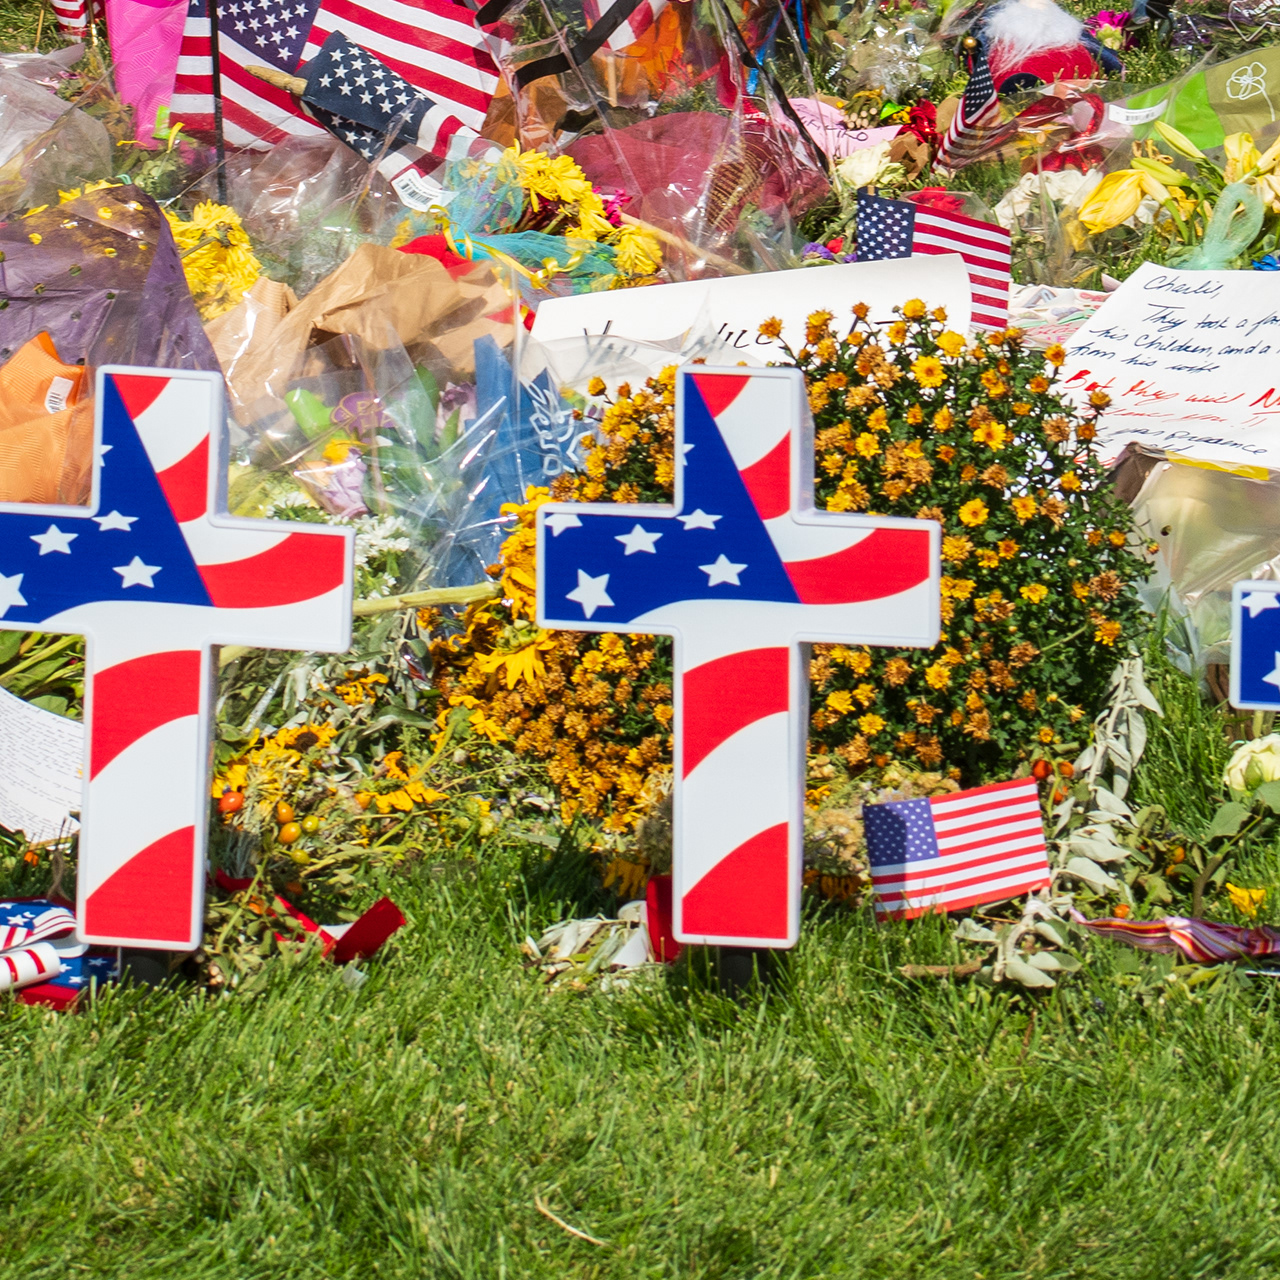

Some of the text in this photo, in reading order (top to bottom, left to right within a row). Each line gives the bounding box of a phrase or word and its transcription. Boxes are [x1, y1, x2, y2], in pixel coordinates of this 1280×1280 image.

[1141, 303, 1186, 333] They
[1195, 313, 1228, 331] took
[1236, 319, 1249, 329] a
[1088, 325, 1129, 342] his
[1217, 342, 1257, 357] and
[1259, 345, 1272, 355] a
[1120, 354, 1159, 370] his
[1120, 378, 1180, 408] they
